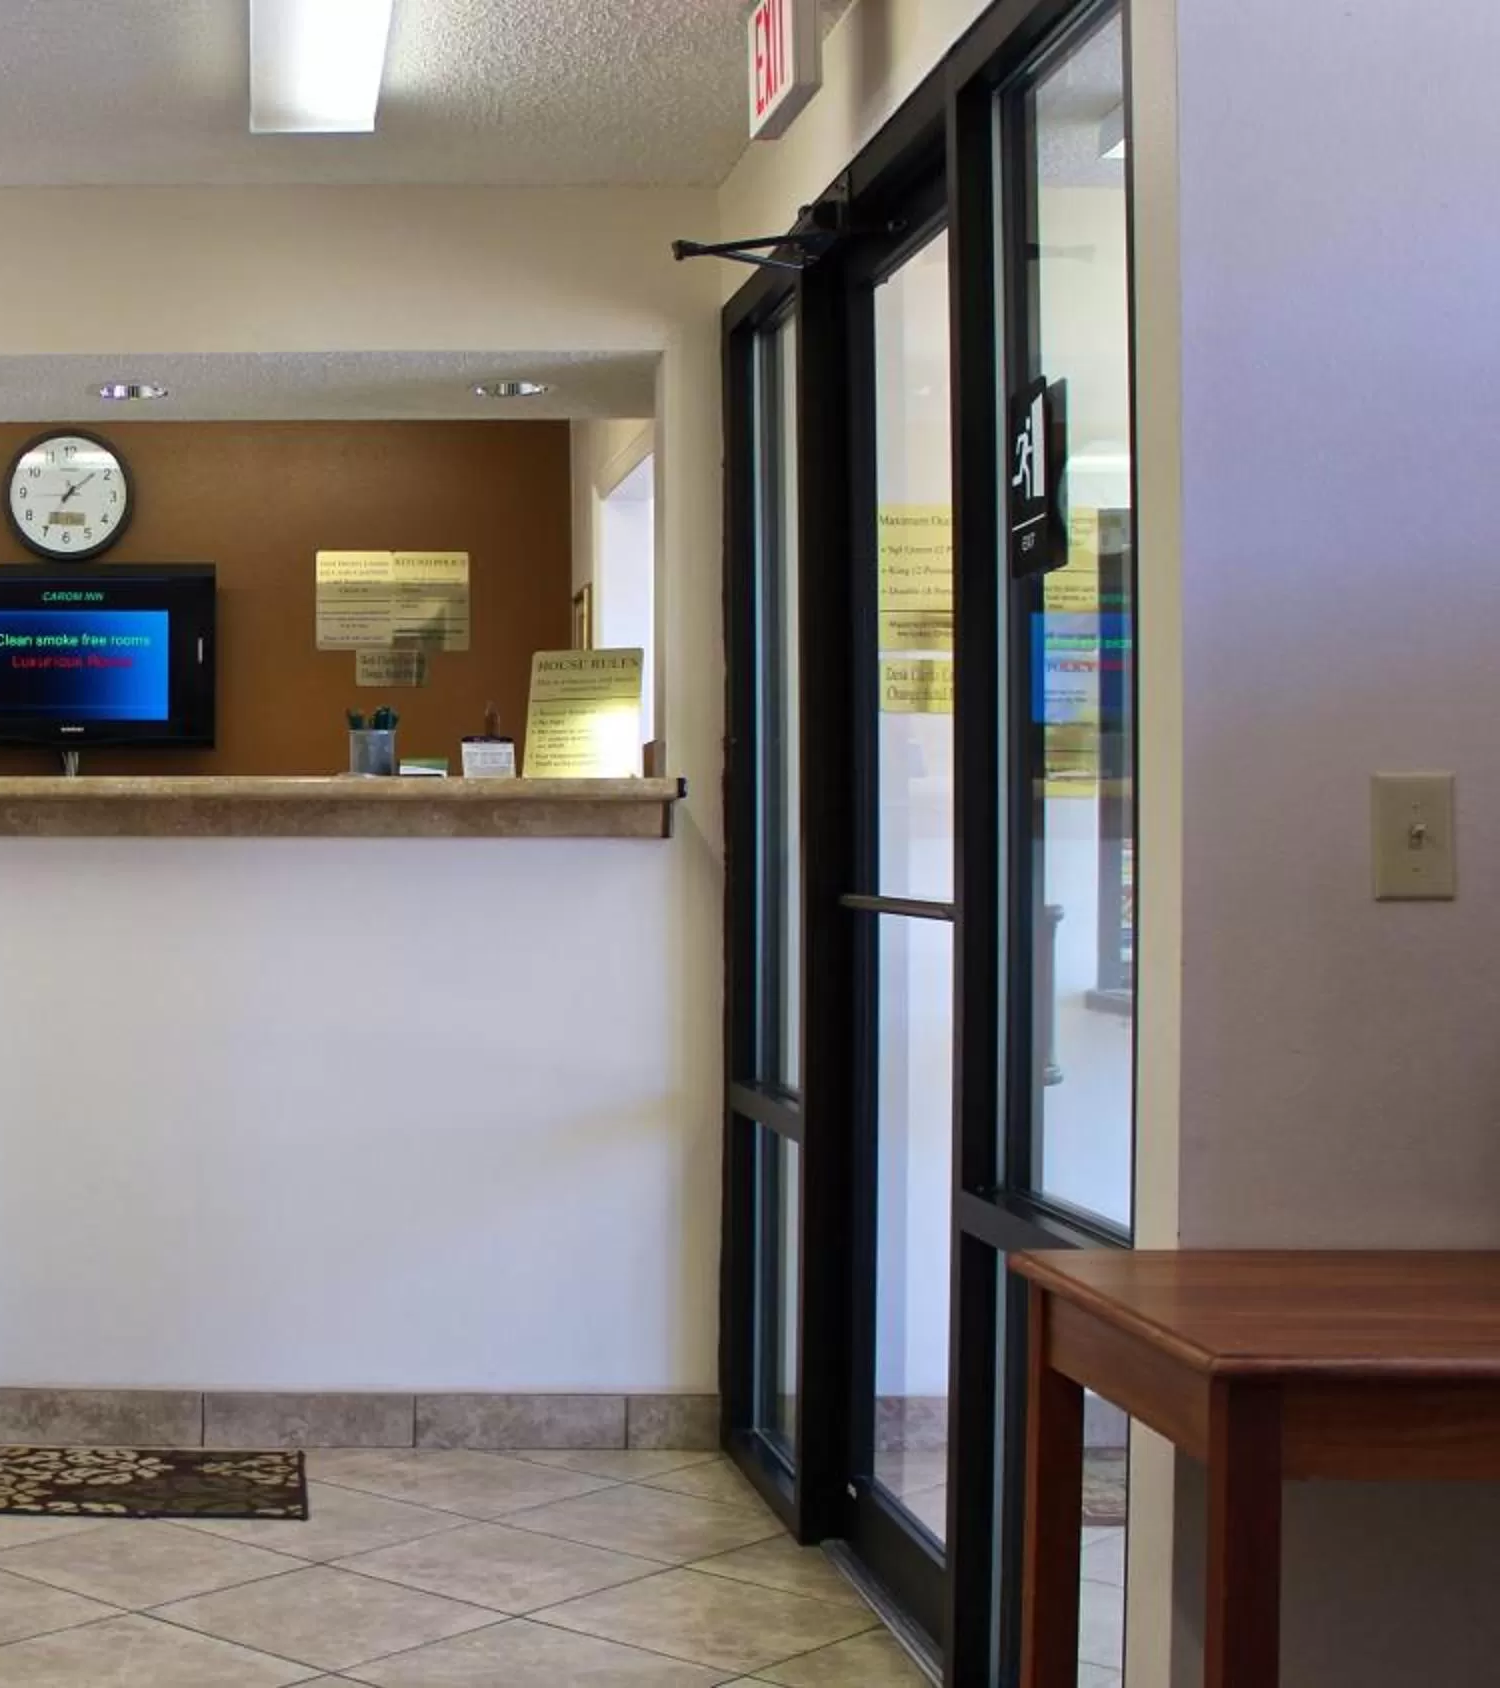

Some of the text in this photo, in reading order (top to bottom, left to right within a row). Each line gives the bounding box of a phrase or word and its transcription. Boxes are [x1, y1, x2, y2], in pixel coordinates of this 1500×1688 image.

[755, 0, 785, 116] EXIT
[64, 446, 77, 459] 12
[28, 467, 41, 478] 10
[103, 469, 111, 481] 2
[19, 487, 28, 499] 9
[110, 491, 117, 504] 3
[25, 509, 33, 521] 8
[100, 513, 109, 524] 4
[41, 525, 50, 538] 7
[83, 527, 92, 540] 5
[61, 532, 71, 545] 6
[35, 633, 79, 647] smoke
[81, 632, 107, 647] free
[111, 634, 150, 647] rooms
